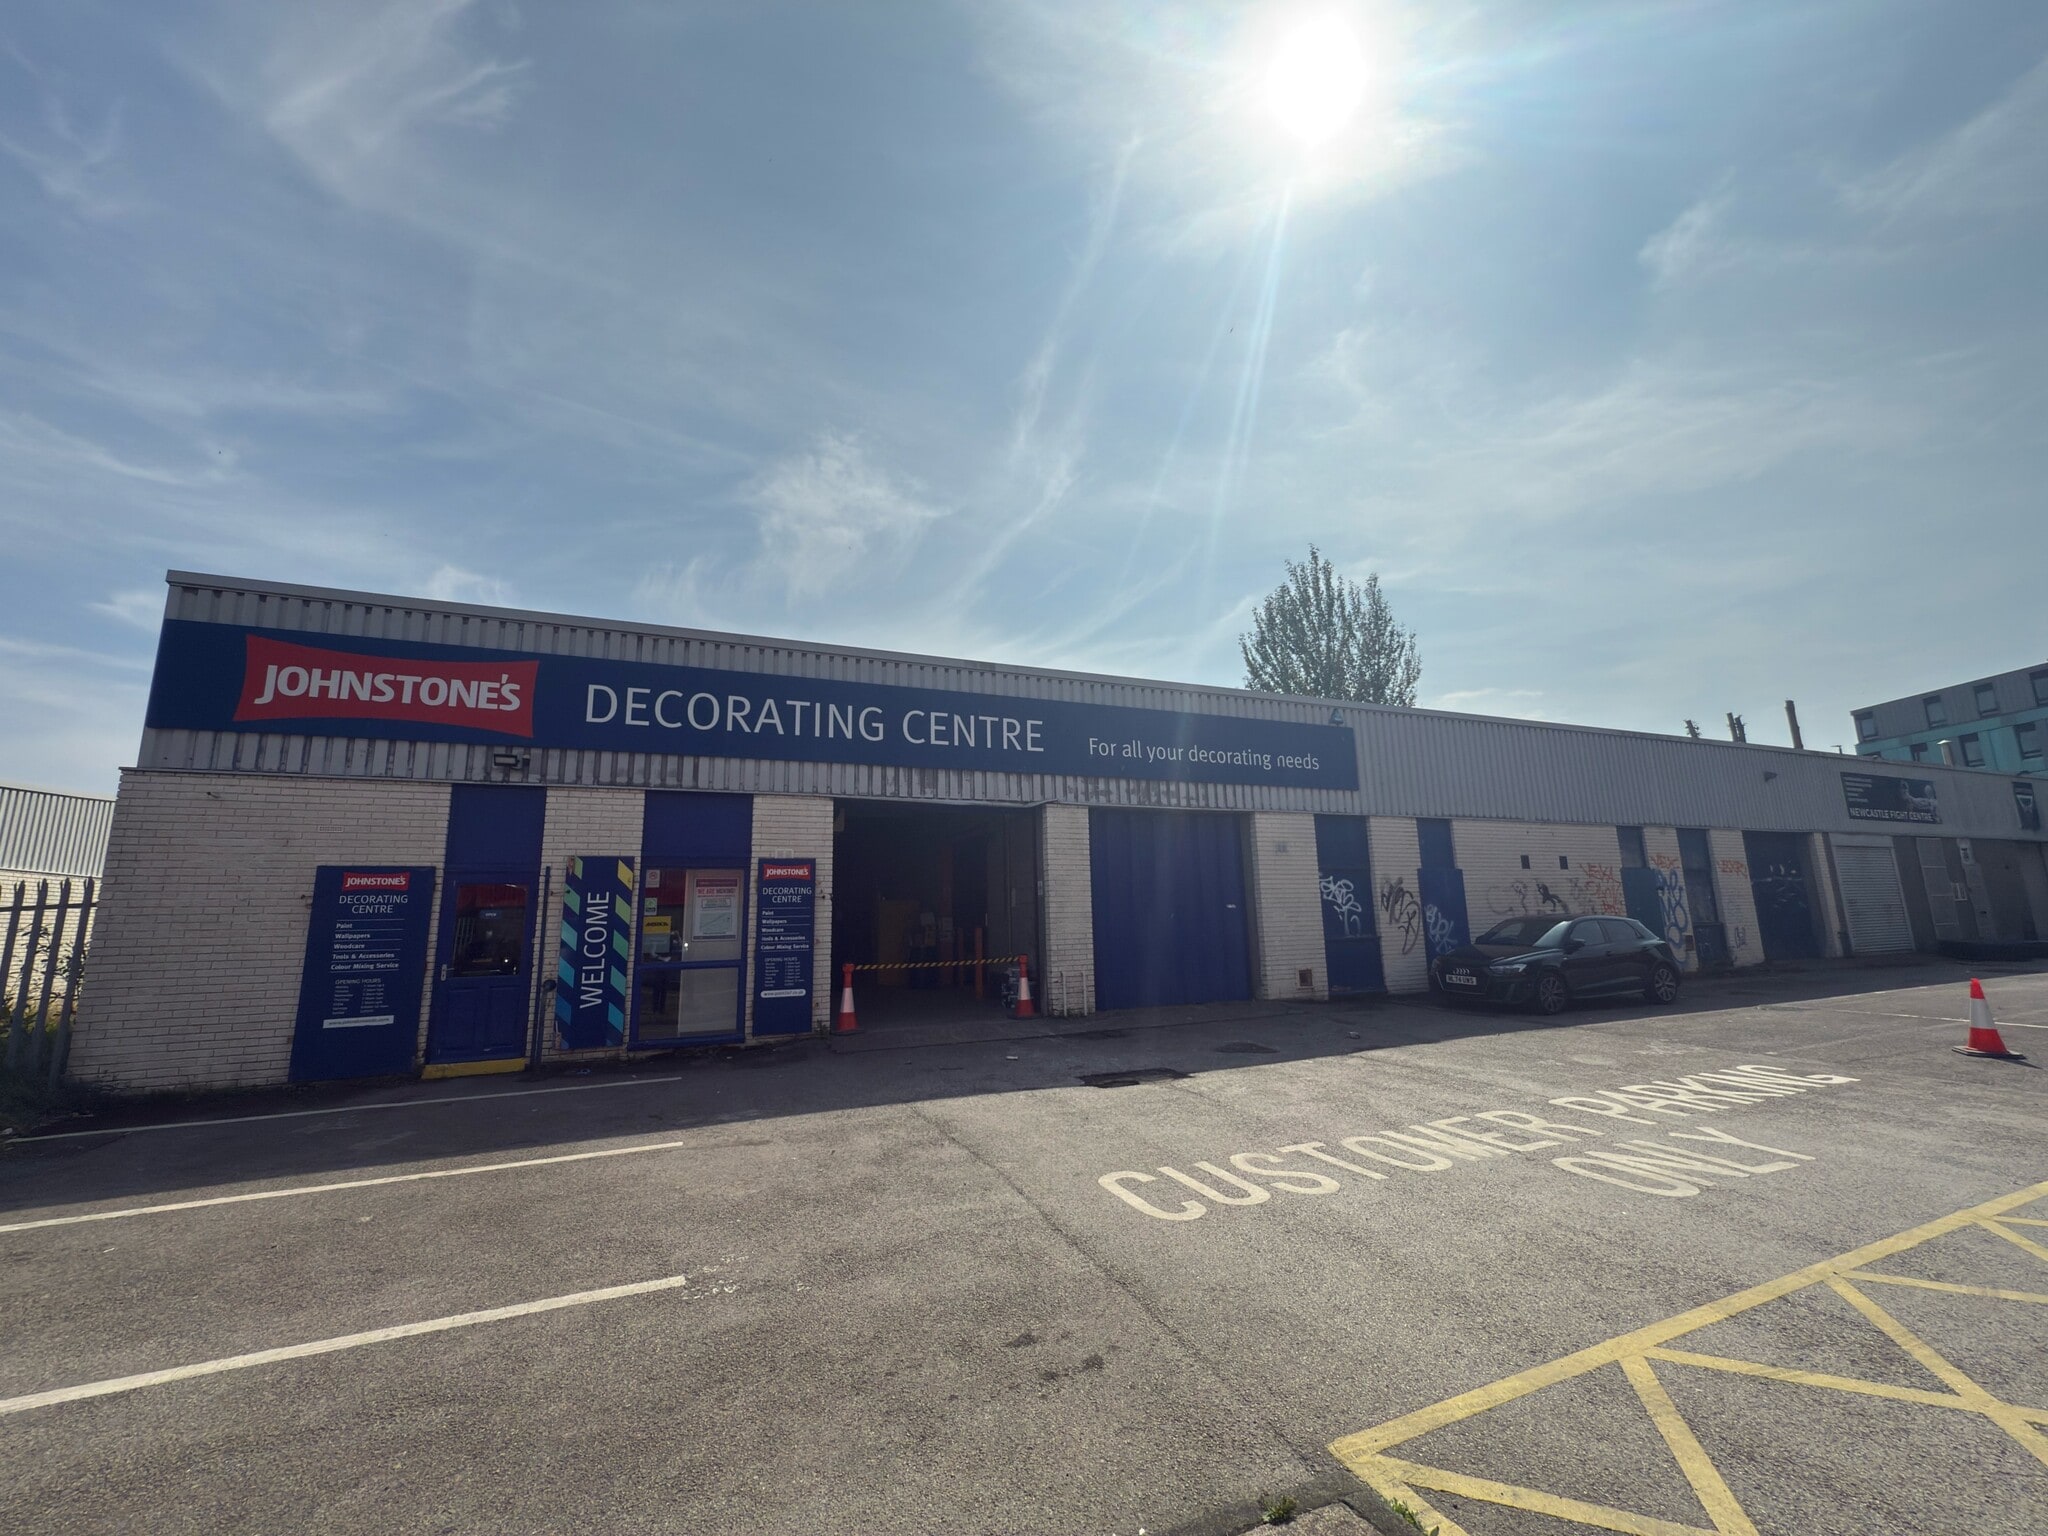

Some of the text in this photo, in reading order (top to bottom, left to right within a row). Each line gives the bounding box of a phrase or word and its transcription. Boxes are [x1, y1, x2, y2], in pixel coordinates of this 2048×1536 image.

[253, 664, 521, 711] JOHNSTONE'S
[584, 683, 1045, 752] DECORATING CENTRE
[1089, 737, 1320, 770] For all your decorating needs
[1849, 807, 1934, 822] NEWCASTLE FIGHT CENTRE
[766, 867, 809, 877] JOHNSTONE'S
[345, 875, 407, 888] JOHNSTONE'S
[762, 887, 812, 895] DECORATING
[338, 894, 409, 904] DECORATING
[771, 895, 802, 903] CENTRE
[351, 904, 394, 914] CENTRE
[335, 932, 371, 940] Wallpapers
[579, 891, 609, 1009] WELCOME
[358, 952, 395, 960] Accessories
[330, 962, 400, 971] Colour Mixing Service
[1098, 1064, 1861, 1222] CUSTOMER PARKING
[1551, 1126, 1817, 1198] ONLY
